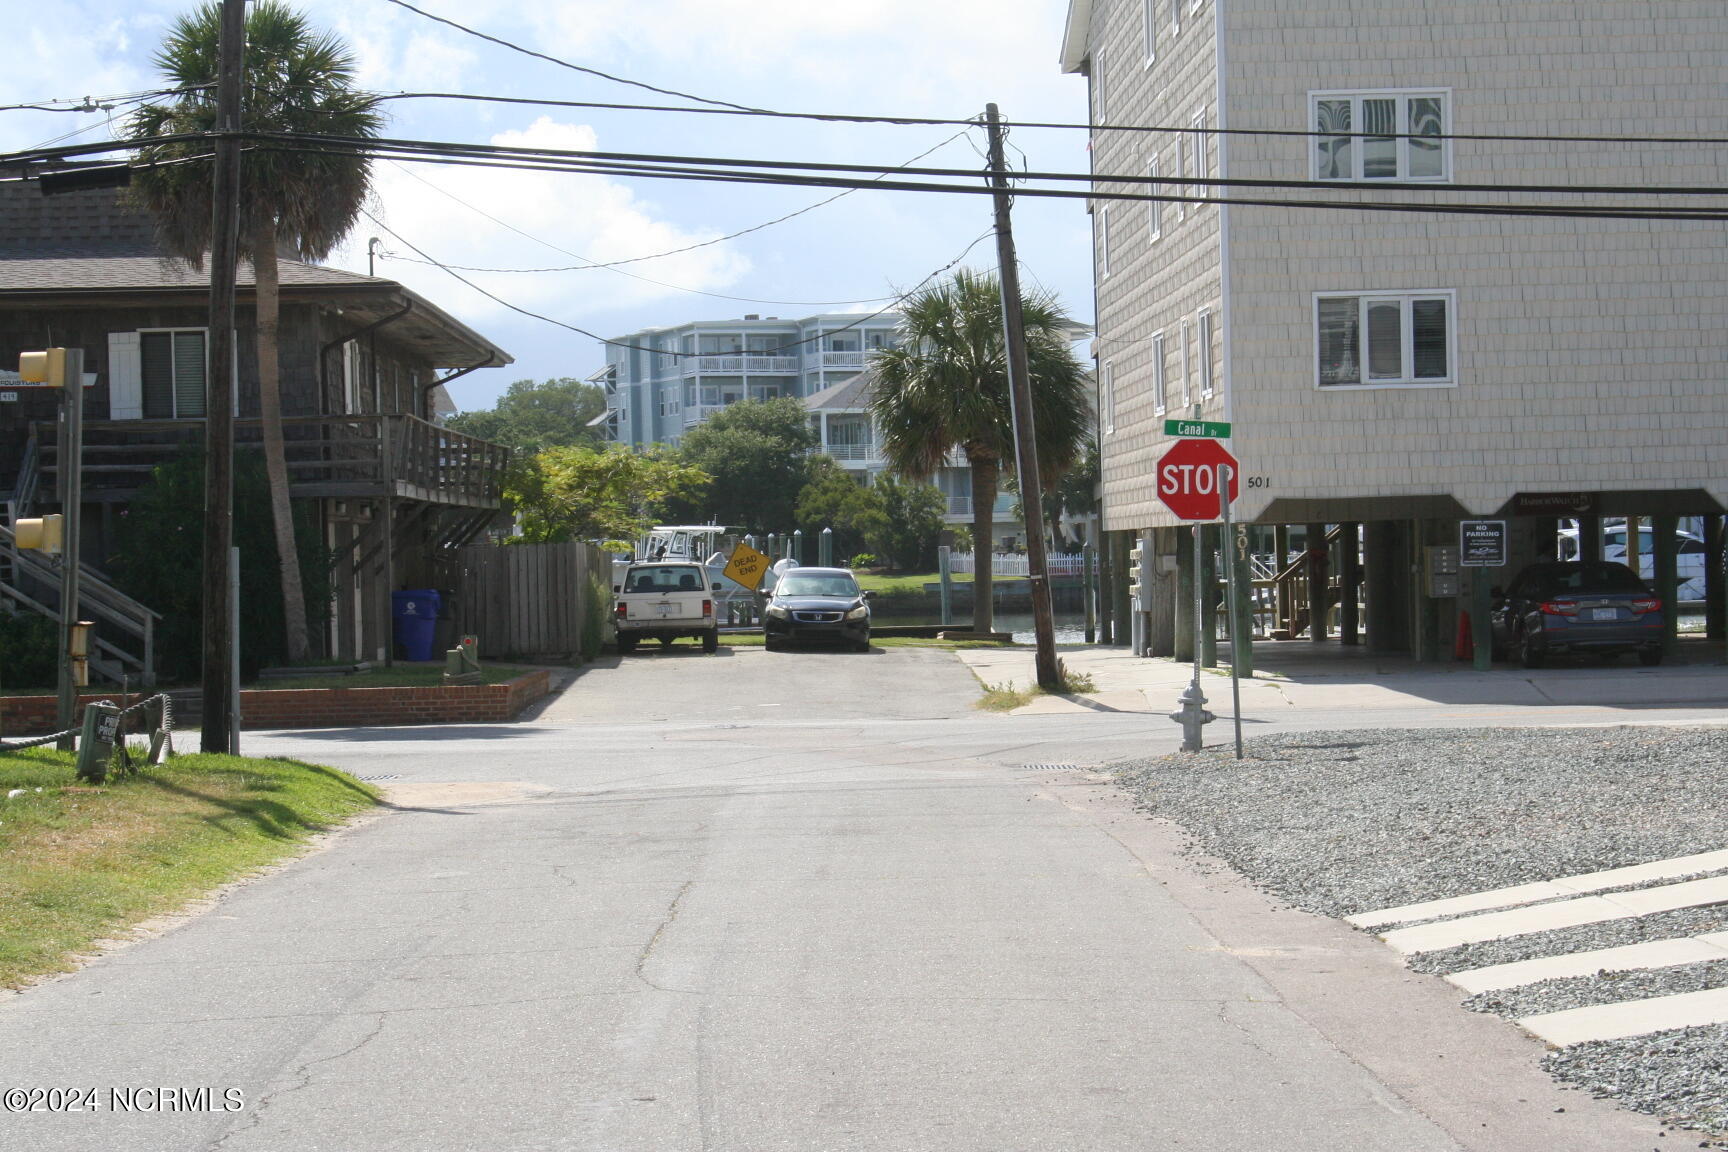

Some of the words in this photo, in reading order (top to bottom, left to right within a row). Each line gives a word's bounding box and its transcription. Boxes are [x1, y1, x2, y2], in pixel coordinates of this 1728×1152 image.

[1178, 422, 1205, 436] Canal
[1161, 464, 1234, 495] STOP
[1248, 476, 1270, 489] 501
[734, 554, 757, 568] DEAD
[739, 565, 757, 576] END
